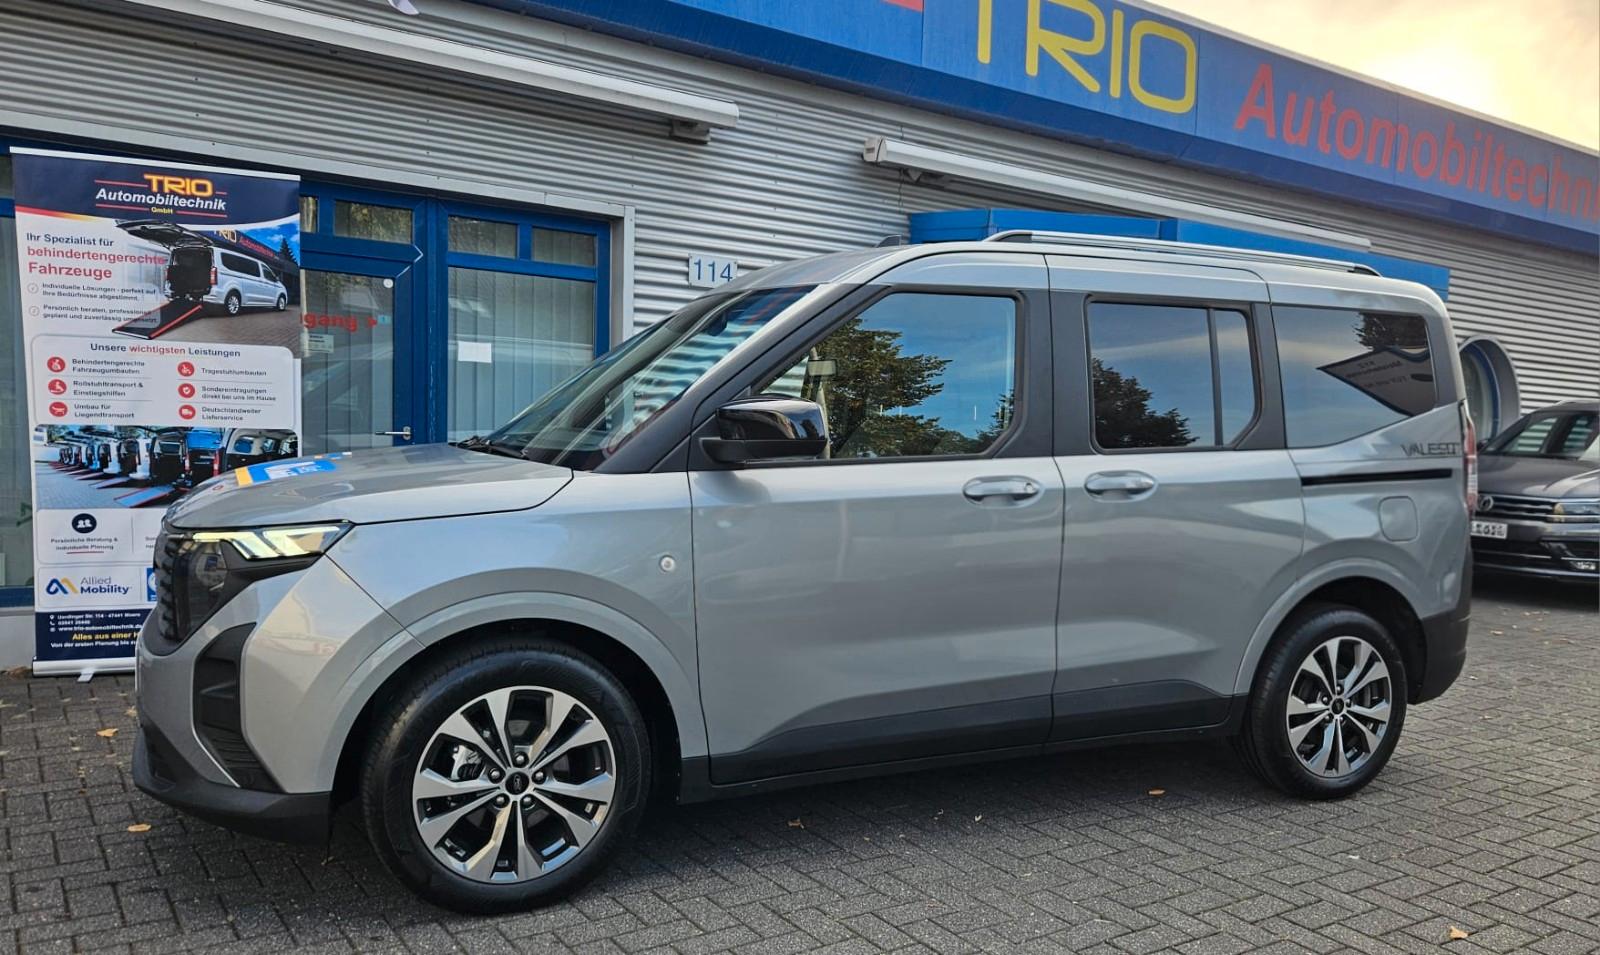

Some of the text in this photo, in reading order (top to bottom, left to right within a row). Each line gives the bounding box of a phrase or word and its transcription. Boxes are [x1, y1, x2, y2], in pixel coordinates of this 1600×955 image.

[143, 173, 213, 197] TRIO
[96, 188, 227, 210] Automobiltechnik
[151, 206, 173, 214] GmbH
[26, 232, 114, 246] Ihr Spezialist für
[28, 262, 112, 280] Fahrzeuge
[694, 259, 733, 282] 114
[299, 312, 357, 333] gang
[90, 343, 241, 358] Unsere wichtigsten Leistungen
[73, 380, 136, 388] Rollstuhltransport
[73, 389, 126, 397] Einstiegshilfen
[74, 411, 135, 419] Liegendtransport
[80, 576, 111, 585] Allied
[80, 584, 129, 595] Mobility
